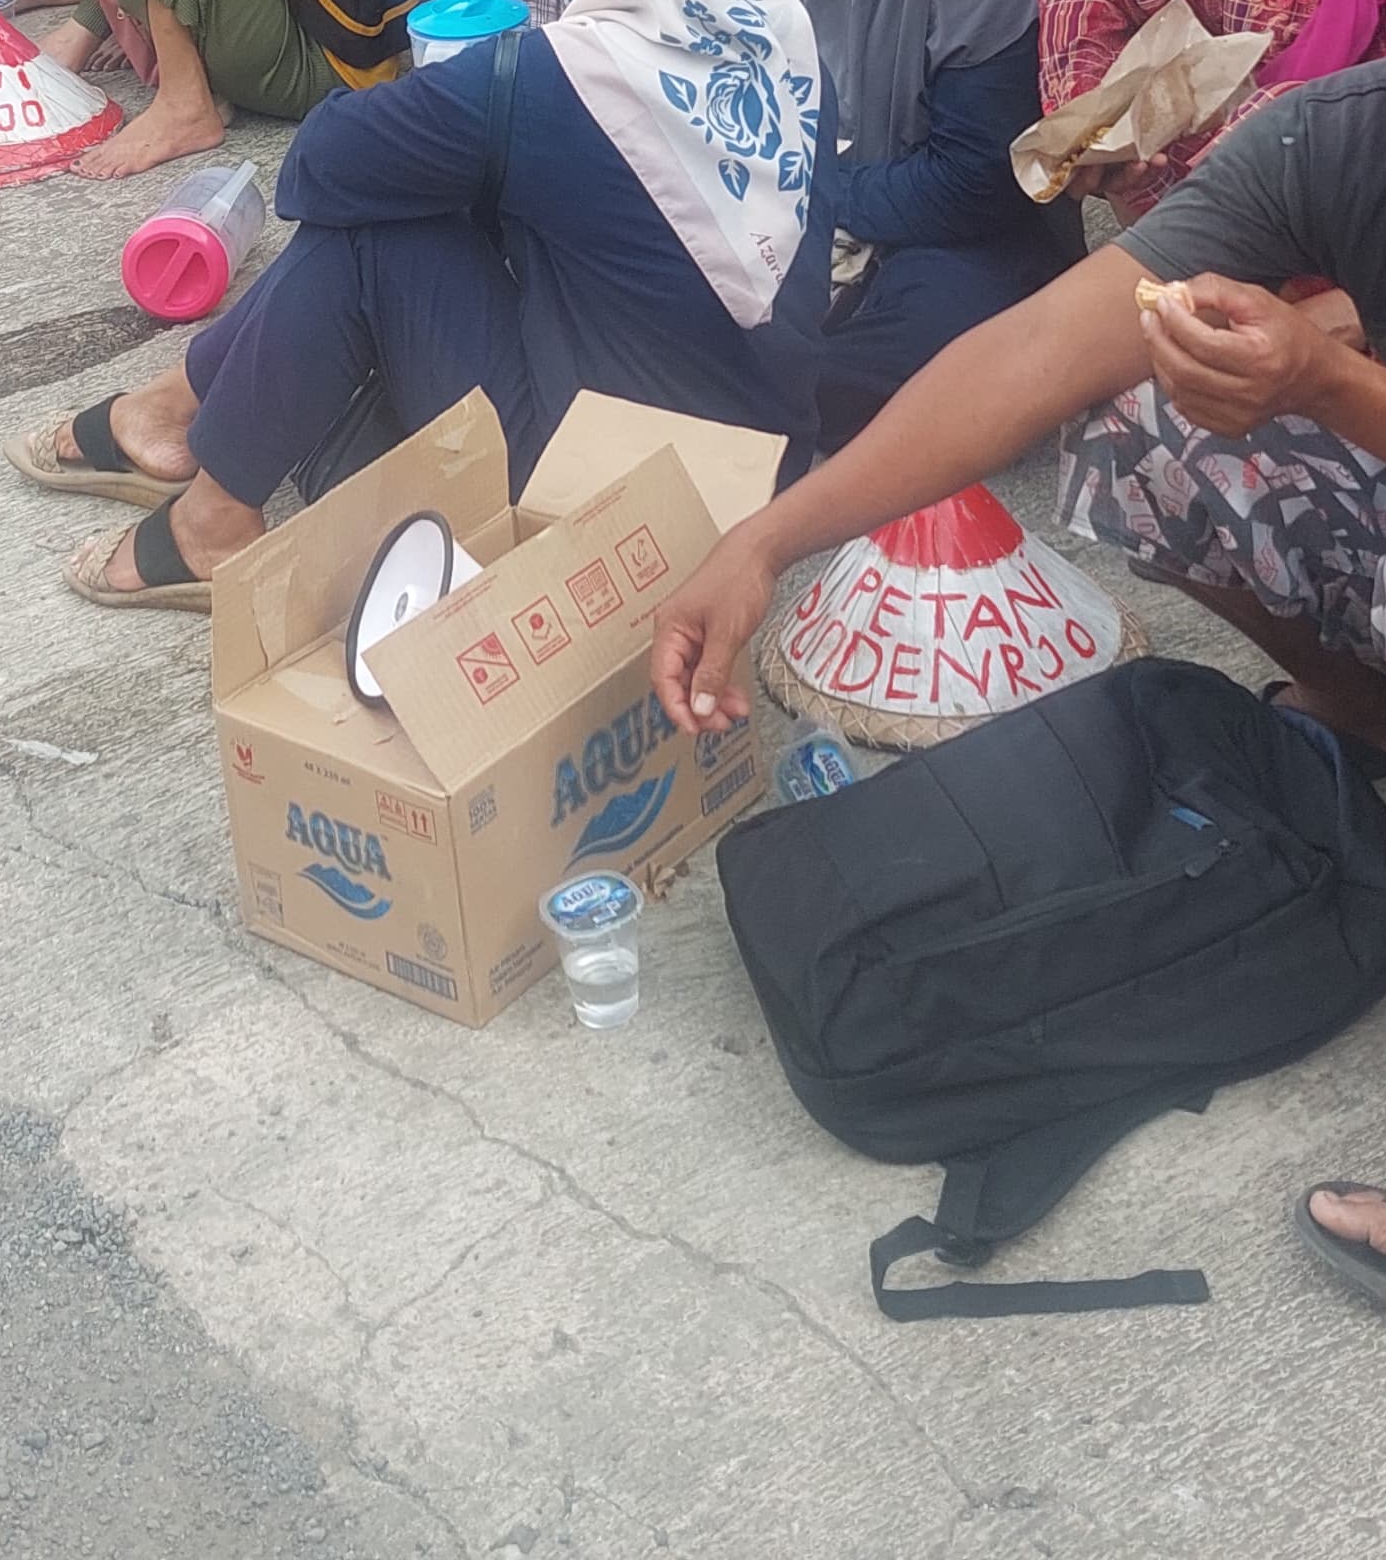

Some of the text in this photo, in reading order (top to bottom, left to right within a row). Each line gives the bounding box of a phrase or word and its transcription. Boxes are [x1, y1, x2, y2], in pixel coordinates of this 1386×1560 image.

[841, 548, 1064, 649] PETANI
[551, 689, 680, 828] AQUA
[285, 800, 392, 882] AQUA
